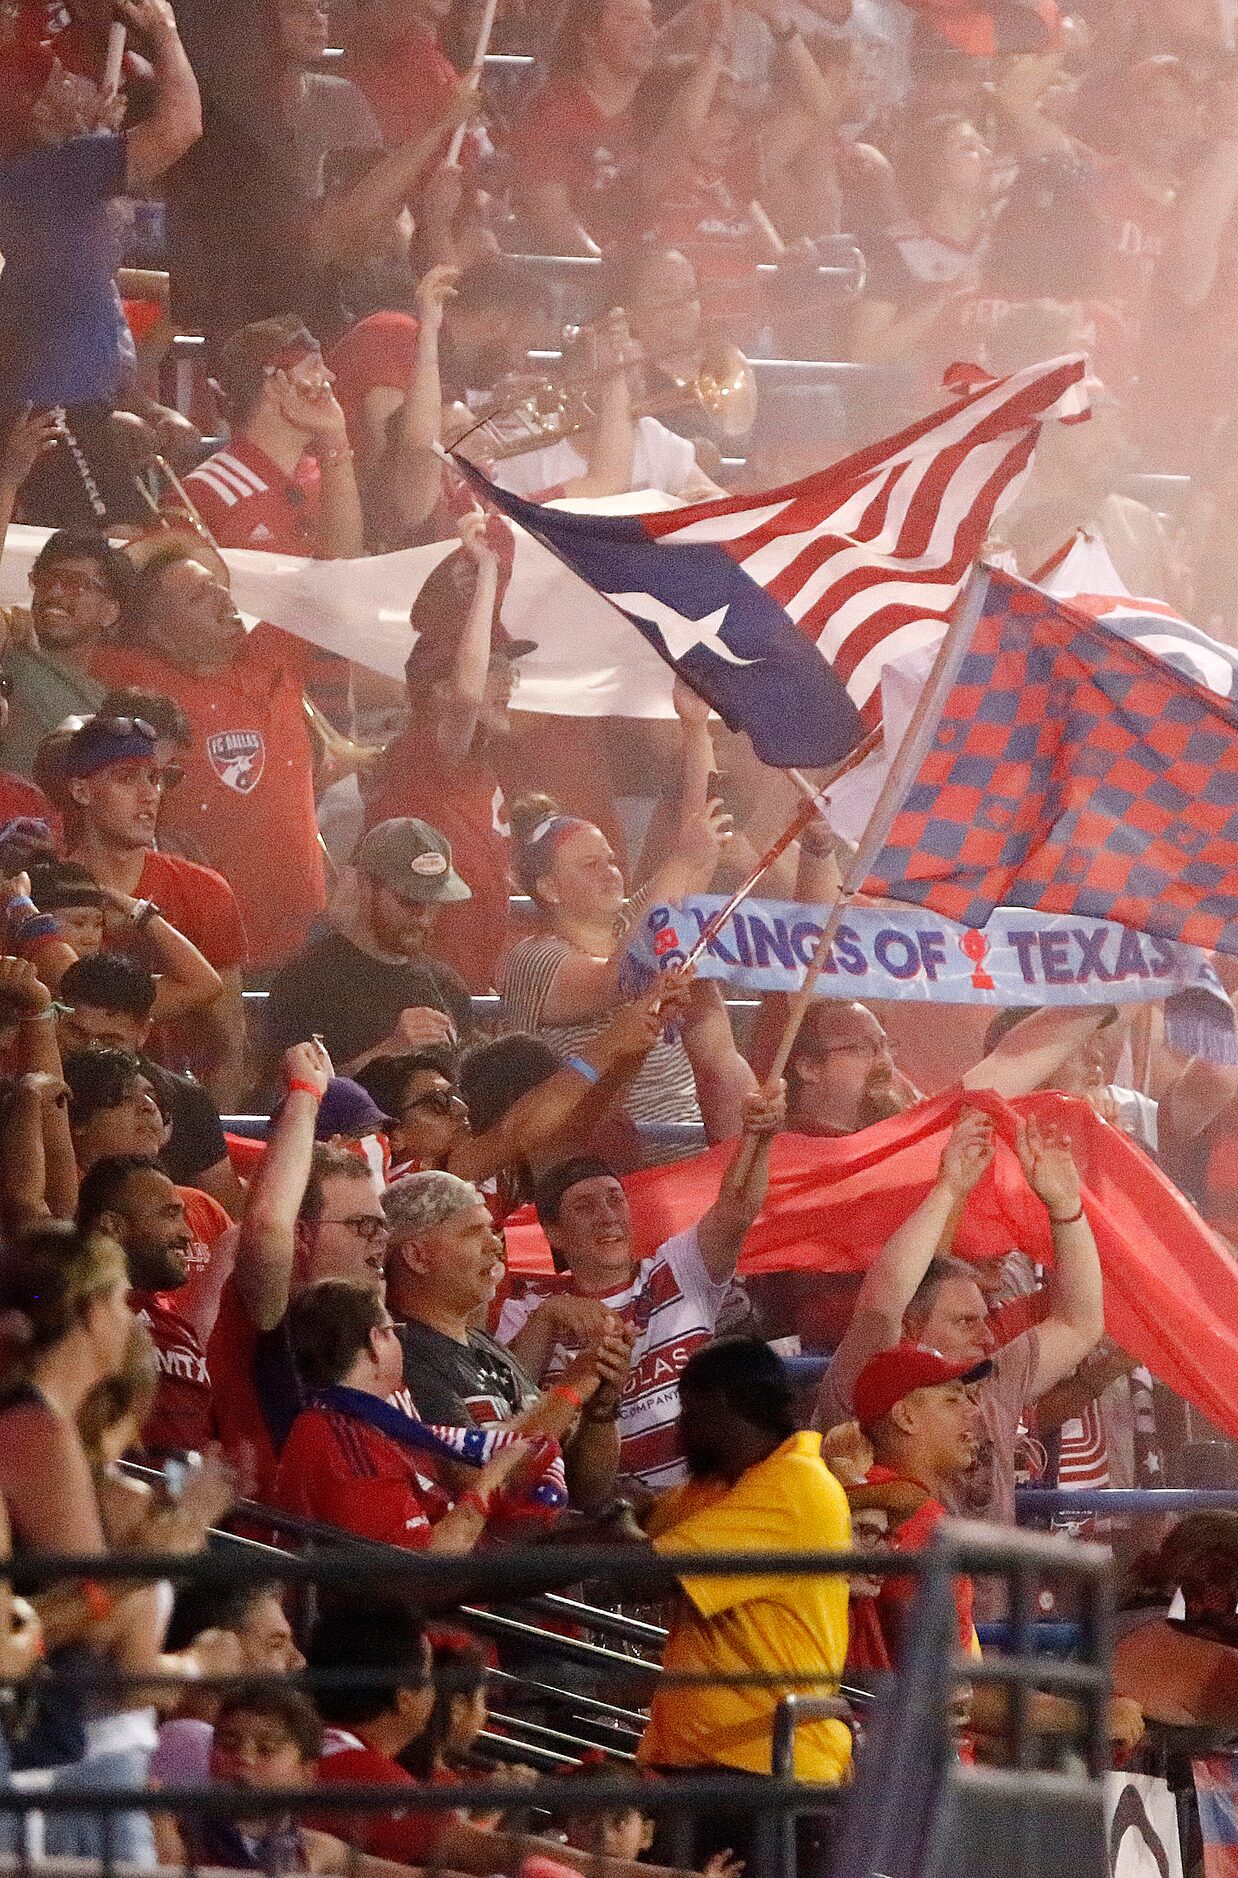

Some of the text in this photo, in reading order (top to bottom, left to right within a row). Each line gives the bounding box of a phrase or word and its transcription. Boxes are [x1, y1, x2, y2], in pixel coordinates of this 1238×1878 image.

[688, 907, 869, 976] KINGS
[874, 928, 946, 982] OF
[1007, 926, 1178, 985] TEXAS
